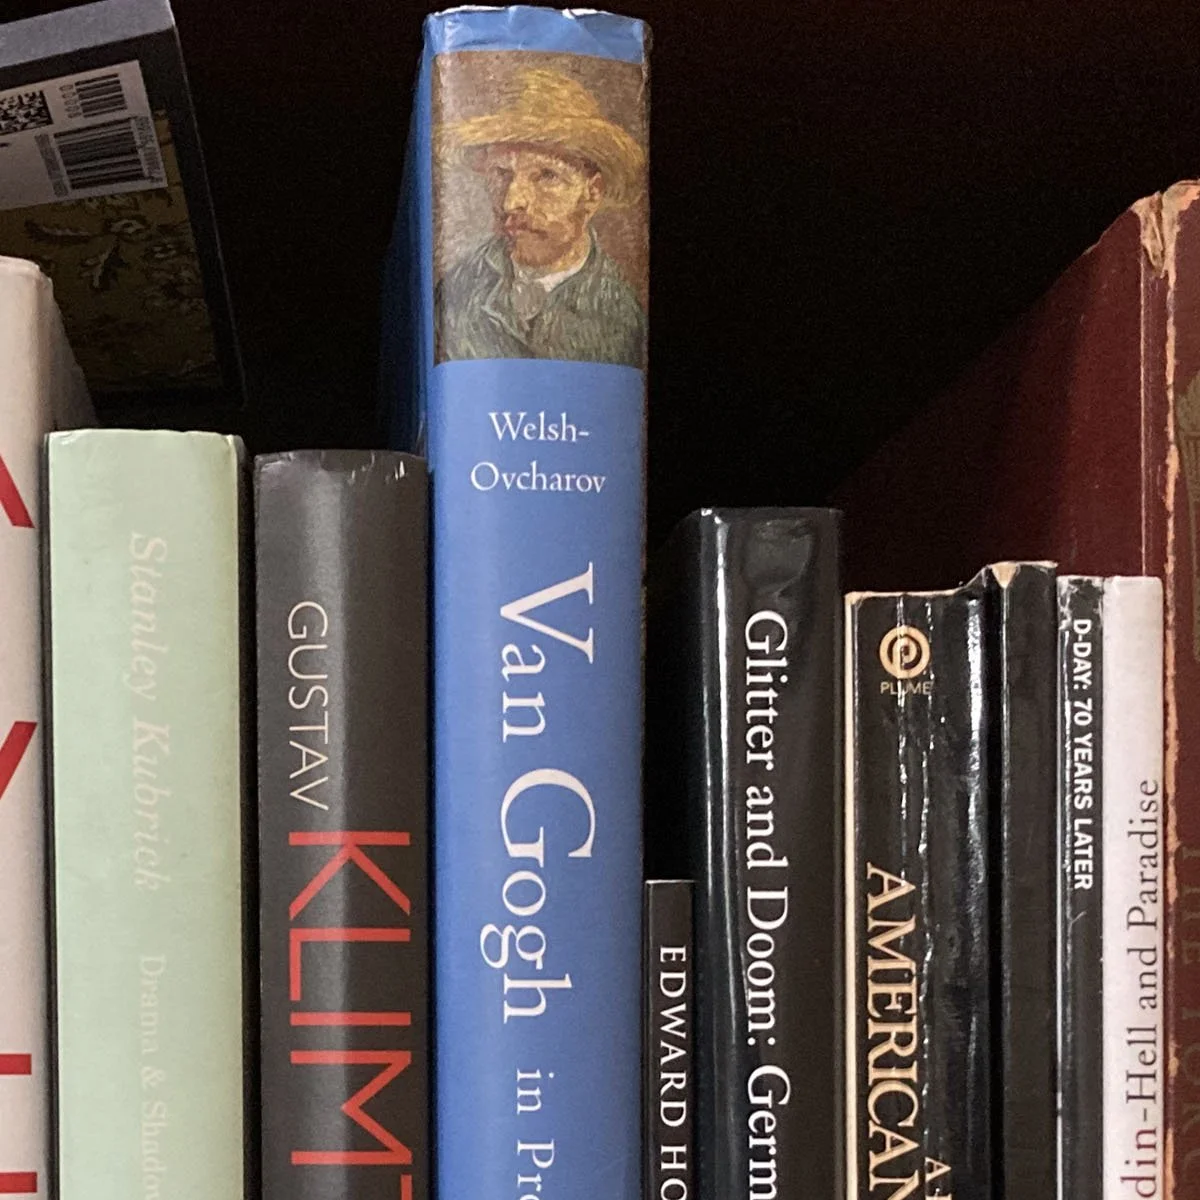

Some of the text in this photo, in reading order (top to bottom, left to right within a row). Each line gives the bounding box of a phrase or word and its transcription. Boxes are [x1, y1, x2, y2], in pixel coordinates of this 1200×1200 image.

[470, 462, 606, 494] Ovcharov
[489, 411, 590, 442] Welsh-
[123, 532, 171, 890] Stanley Kubrick
[288, 601, 329, 810] GUSTAV
[745, 610, 789, 770] Glitter
[880, 681, 933, 695] PLUME
[479, 562, 596, 1023] Van Gogh
[1072, 619, 1094, 890] D-DAY: 70 YEARS LATER
[746, 785, 788, 869] and
[1126, 779, 1159, 929] Paradise
[140, 955, 167, 1053] Drama
[746, 886, 789, 1045] Doom:
[1126, 947, 1159, 1010] and
[515, 1069, 555, 1114] in
[660, 945, 687, 1128] EDWARD
[925, 1156, 952, 1180] A
